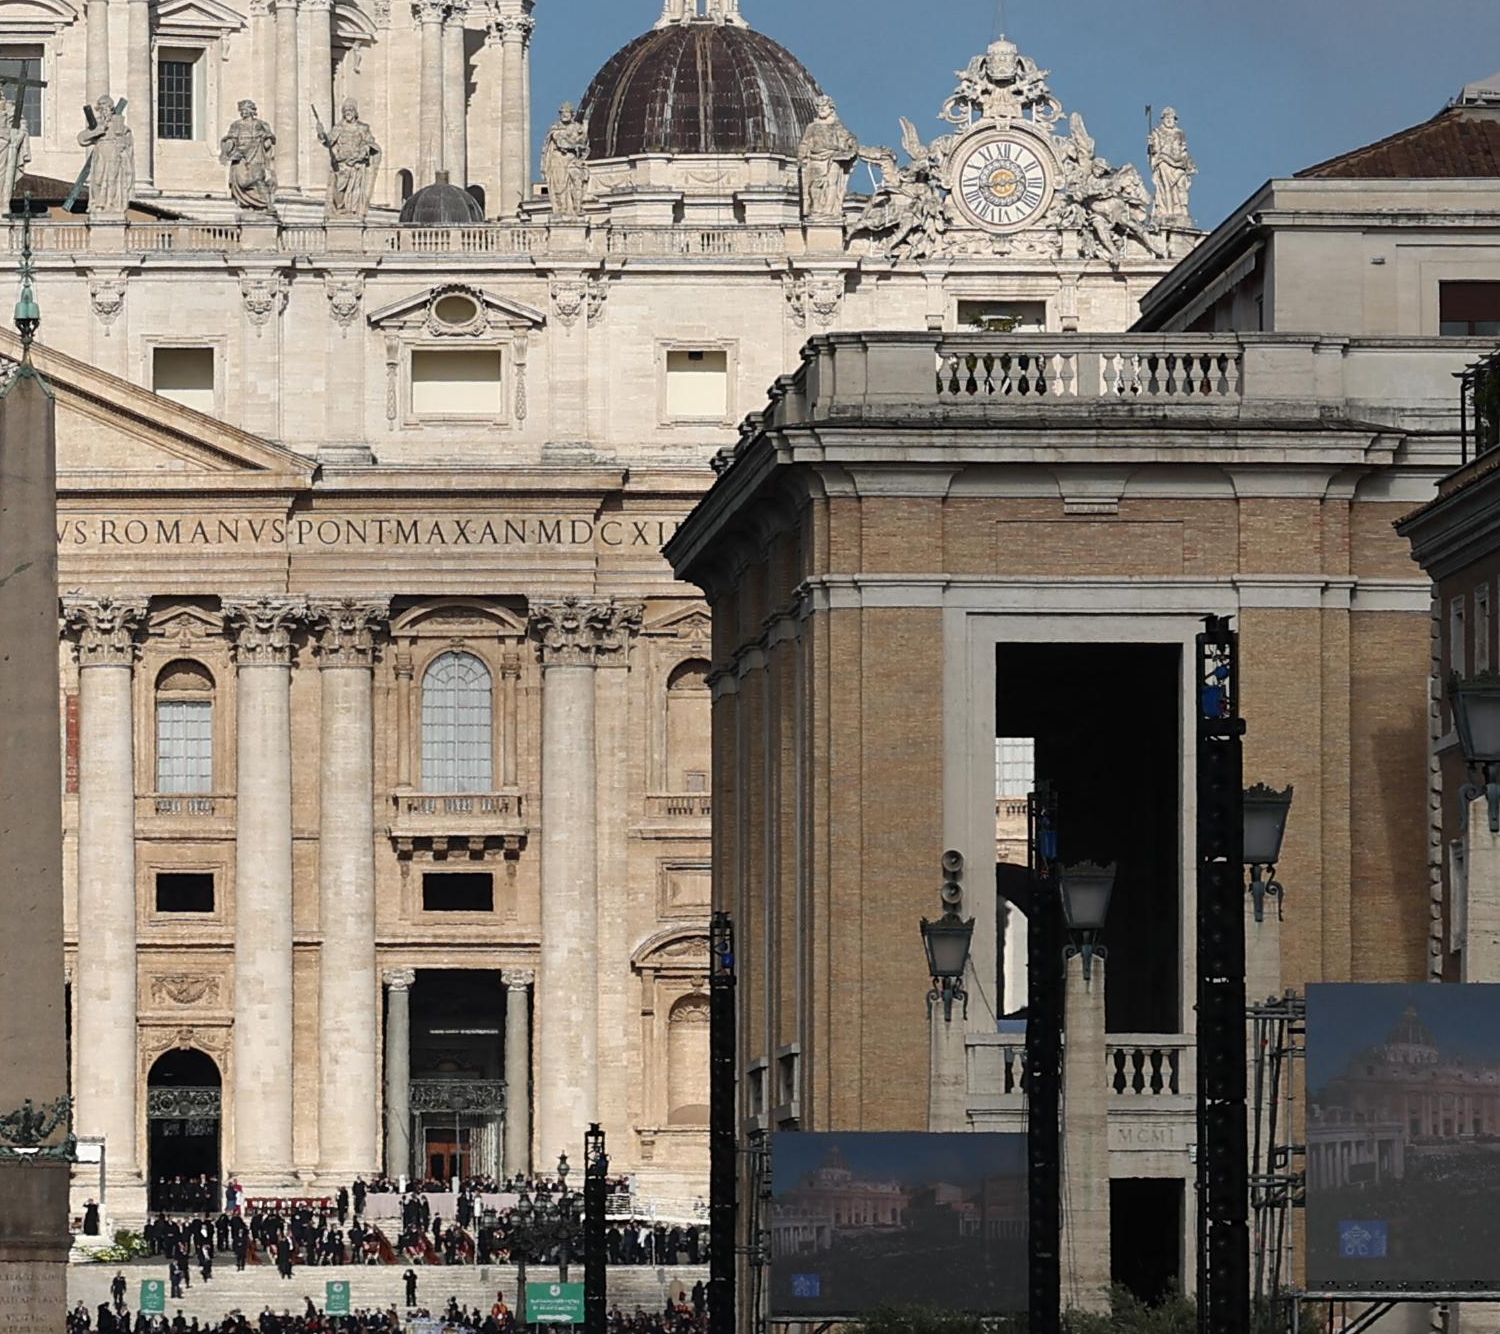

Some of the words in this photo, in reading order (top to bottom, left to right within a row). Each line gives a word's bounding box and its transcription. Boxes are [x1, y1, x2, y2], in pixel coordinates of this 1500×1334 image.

[100, 517, 286, 543] ROMANVS
[297, 517, 393, 543] PONT
[394, 517, 472, 543] MAX
[473, 517, 527, 543] AN
